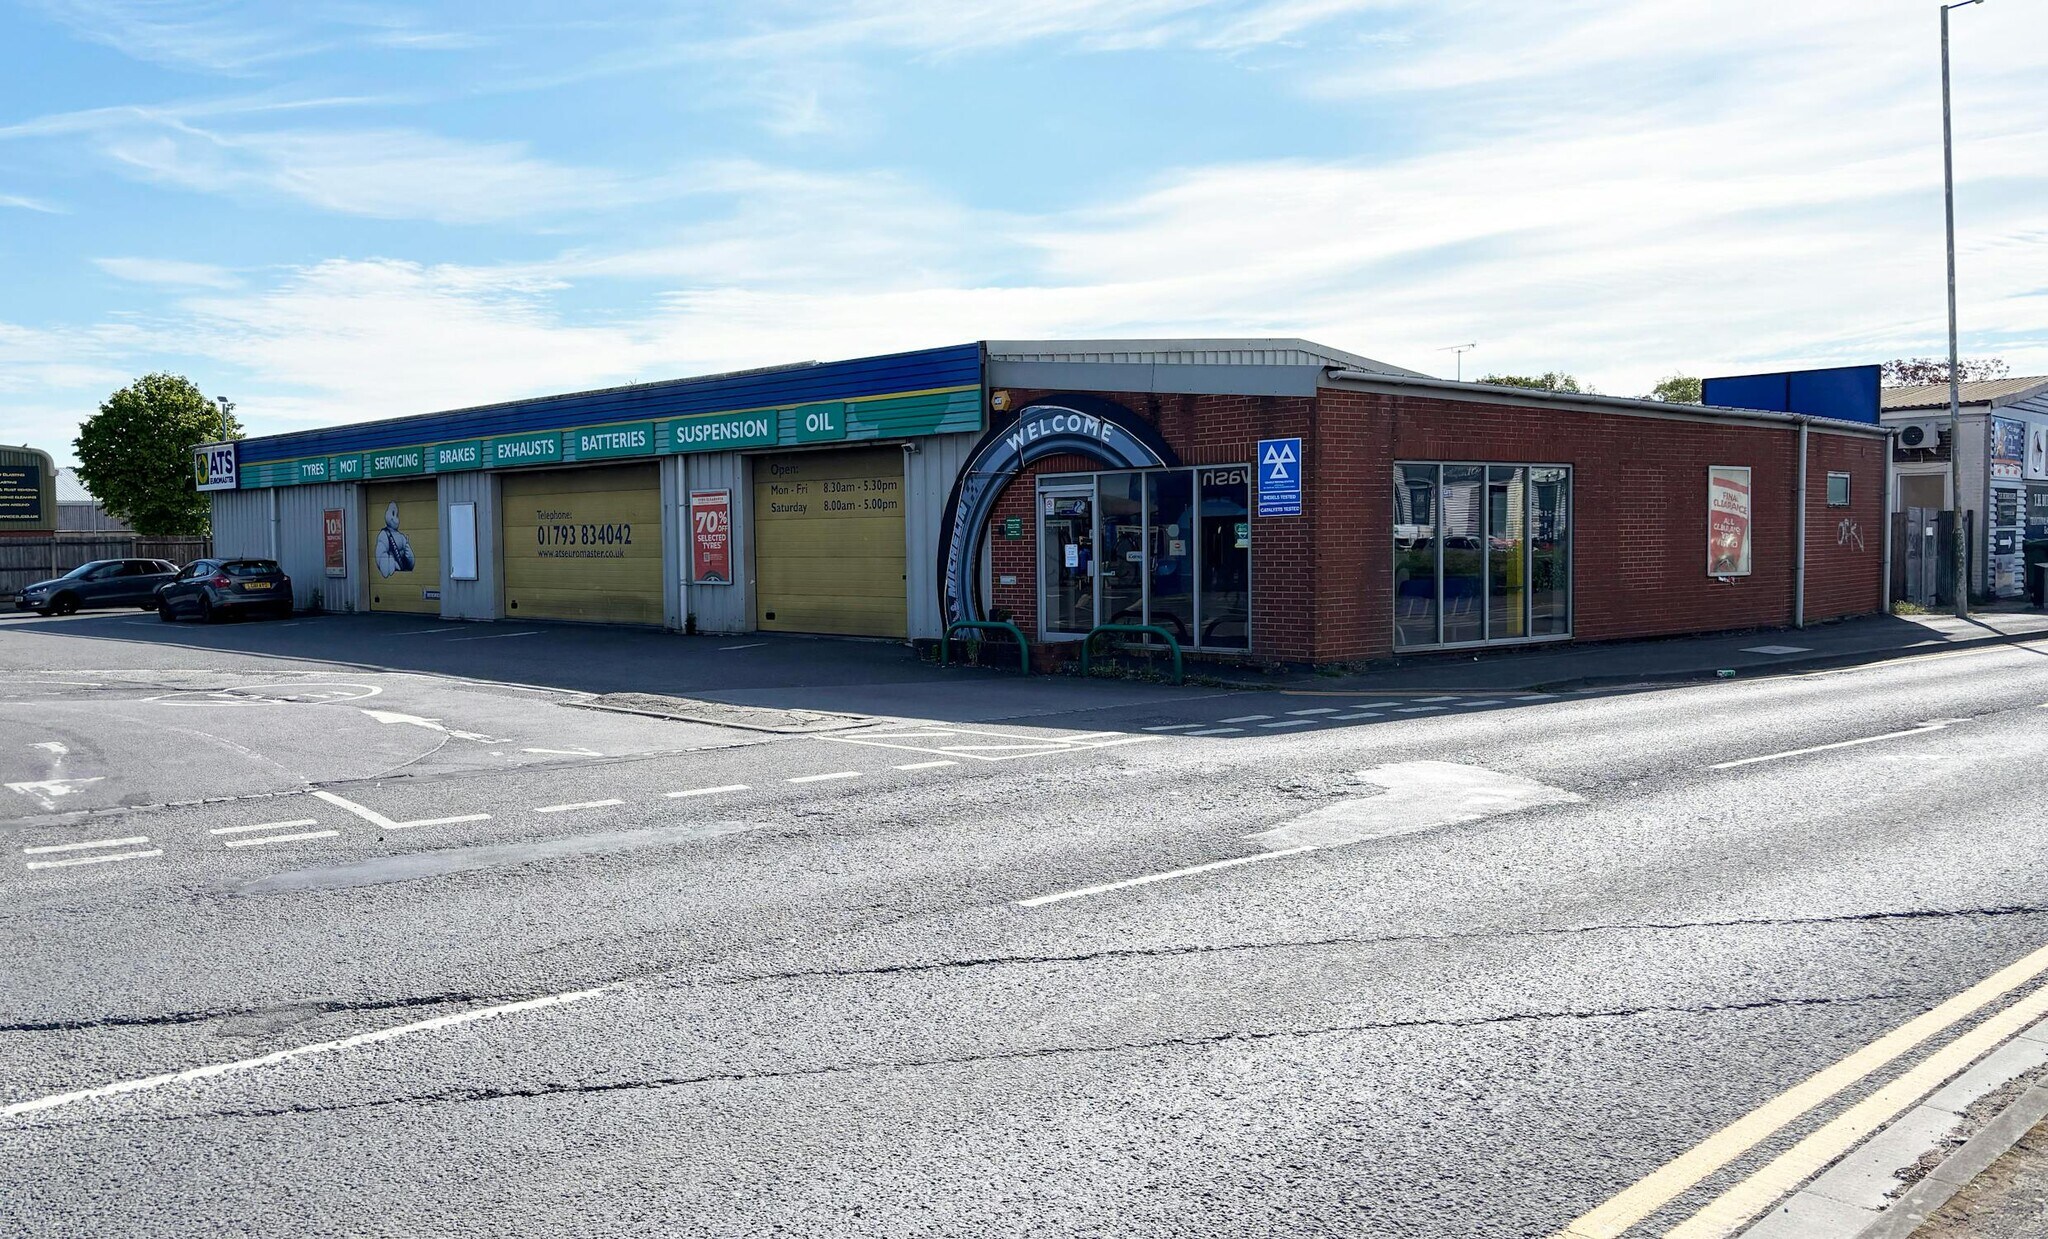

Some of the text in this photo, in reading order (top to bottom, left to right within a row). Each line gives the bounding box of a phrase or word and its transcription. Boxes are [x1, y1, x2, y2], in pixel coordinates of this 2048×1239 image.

[806, 412, 834, 432] OIL
[677, 419, 768, 443] SUSPENSION
[1006, 414, 1113, 451] WELCOME
[497, 439, 554, 458] EXHAUSTS
[581, 430, 646, 451] BATTERIES
[209, 450, 233, 476] ATS
[374, 453, 418, 470] SERVICING
[439, 447, 475, 464] BRAKES
[302, 463, 324, 476] TYRES
[340, 459, 357, 473] MOT
[770, 464, 799, 478] Open:
[770, 485, 789, 495] Mon
[796, 483, 808, 494] Fri
[823, 482, 855, 493] 8.30am
[864, 480, 897, 493] 5.30pm
[771, 502, 808, 515] Saturday
[823, 500, 856, 511] 8.00am
[864, 498, 897, 512] 5.00pm
[537, 510, 572, 522] Telephone:
[537, 523, 632, 545] 01793 834042
[697, 534, 726, 542] SELECTED
[537, 548, 624, 558] www.atseuromaster.co.uk
[947, 501, 968, 597] MICHELIN
